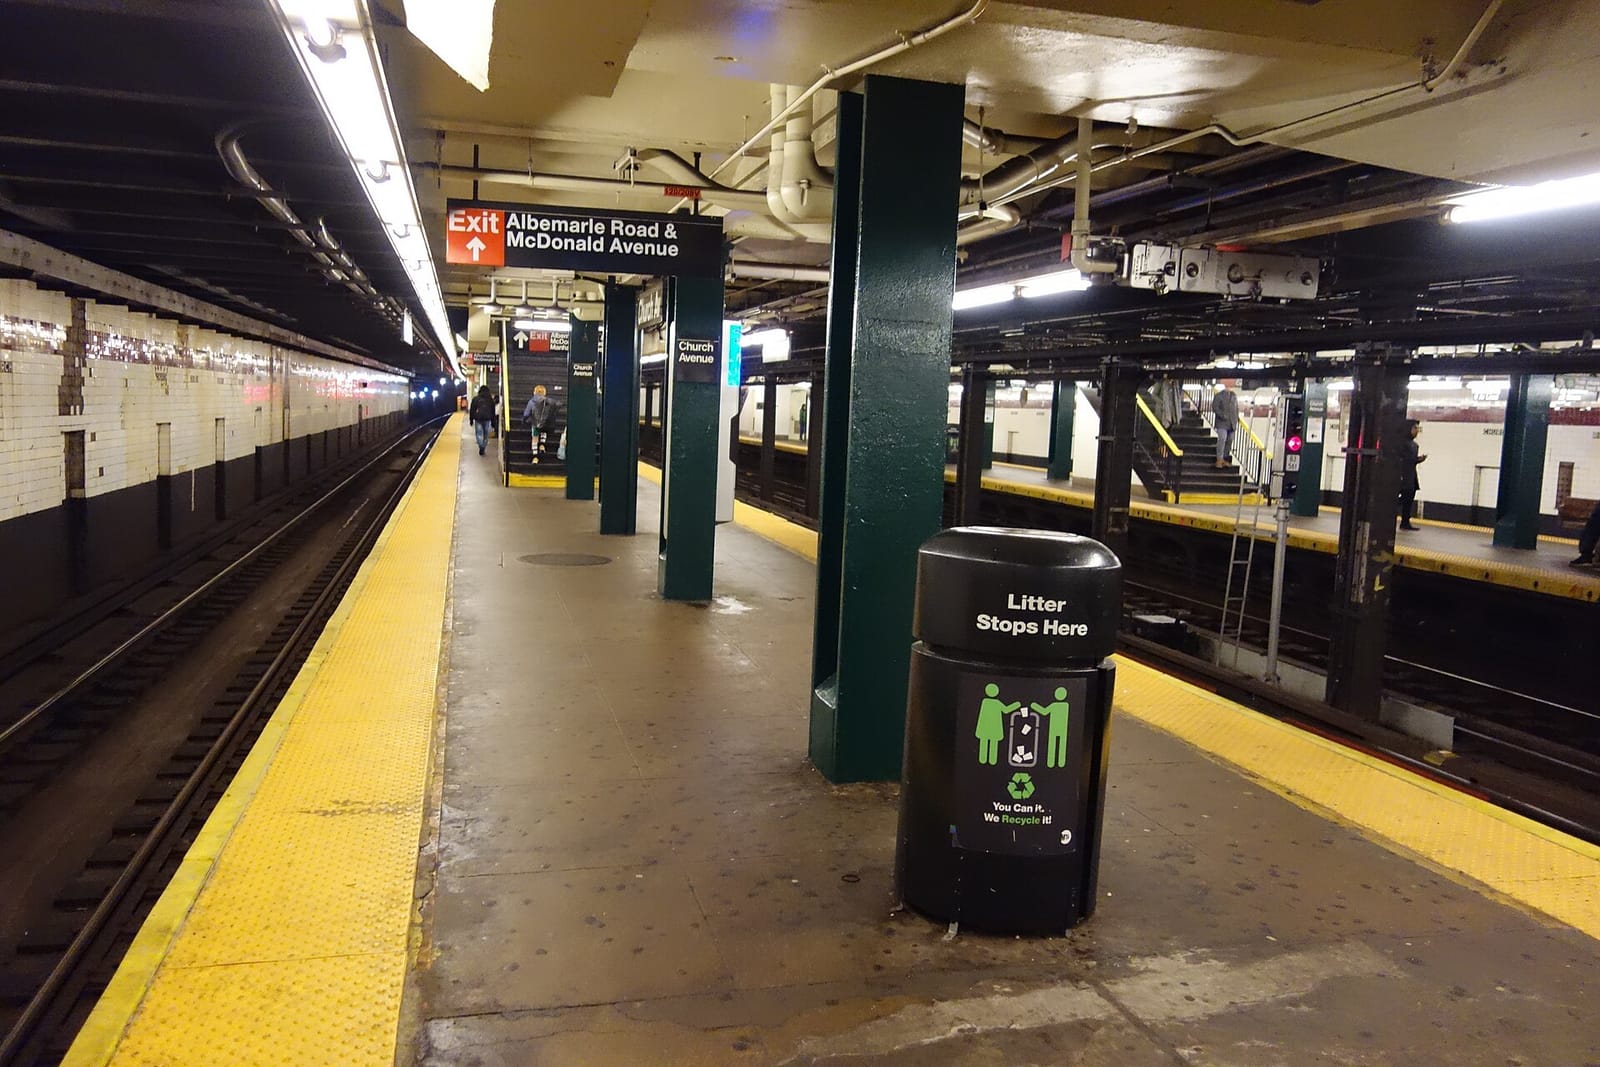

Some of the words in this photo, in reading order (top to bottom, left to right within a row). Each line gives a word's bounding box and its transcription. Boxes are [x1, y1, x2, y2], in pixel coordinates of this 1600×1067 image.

[448, 209, 500, 234] Exit
[506, 213, 605, 235] Albemarle
[610, 219, 660, 238] Road
[664, 223, 678, 239] &
[507, 231, 604, 252] McDonald
[609, 237, 679, 257] Avenue
[530, 331, 548, 340] Exit
[678, 341, 714, 352] Church
[678, 352, 714, 364] Avenue
[1007, 593, 1067, 613] Litter
[976, 613, 1039, 636] Stops
[1043, 619, 1088, 637] Here
[993, 801, 1011, 812] You
[1013, 803, 1033, 813] Can
[984, 812, 1000, 822] We
[1002, 814, 1040, 826] Recycle
[1042, 815, 1052, 825] it!
